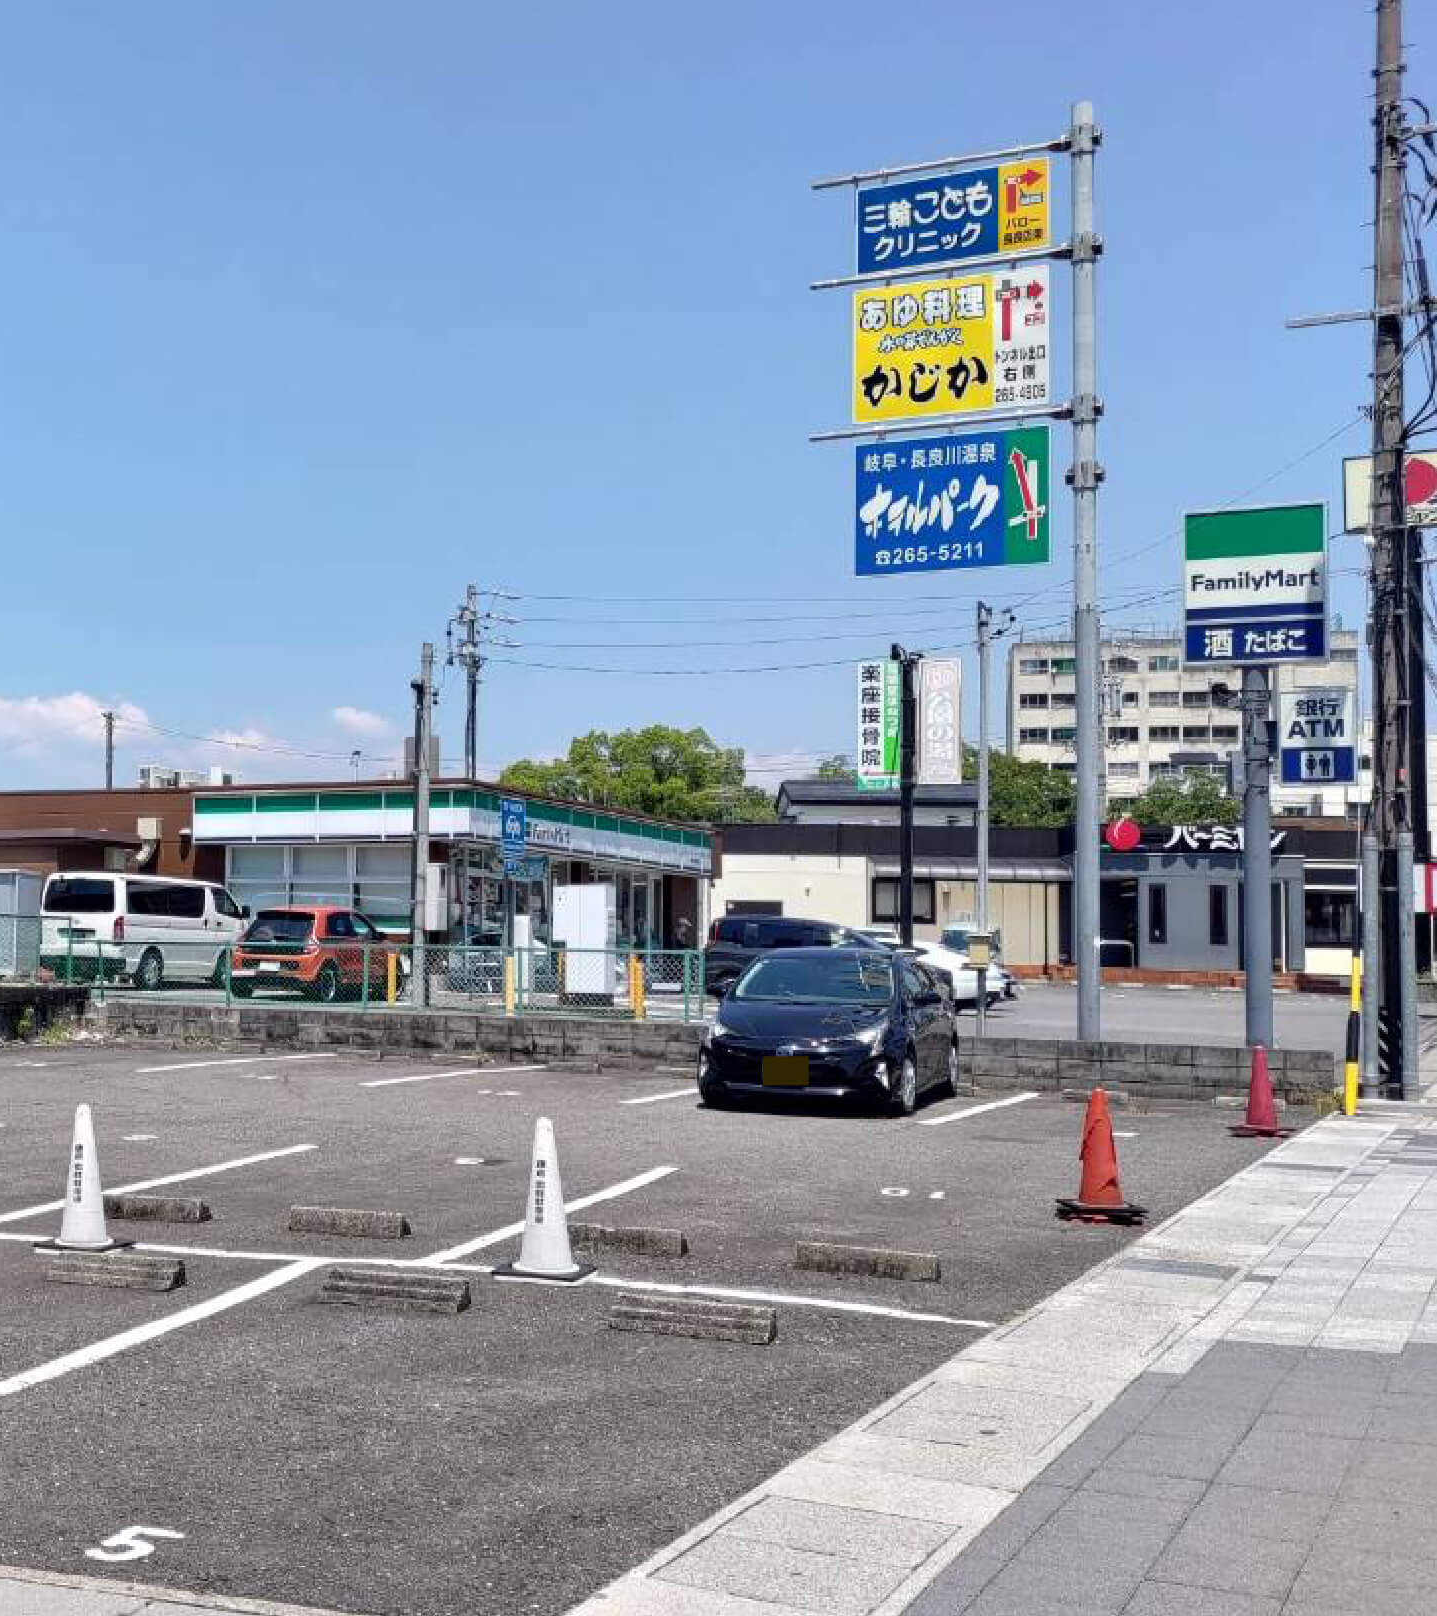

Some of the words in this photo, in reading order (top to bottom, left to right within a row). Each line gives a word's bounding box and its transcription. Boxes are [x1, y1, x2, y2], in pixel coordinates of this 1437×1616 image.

[864, 181, 993, 233] 三輪こども
[874, 222, 981, 261] クリニック
[860, 284, 985, 332] あゆ料理
[862, 356, 989, 408] かじか
[860, 474, 999, 539] ホテルパーク
[1191, 568, 1319, 592] FamilyMart
[1204, 629, 1233, 657] 酒
[1244, 628, 1307, 653] たばこ
[1295, 698, 1341, 717] 銀行
[1287, 719, 1345, 739] ATM
[1164, 825, 1287, 850] バーミン
[84, 1526, 185, 1561] 5
